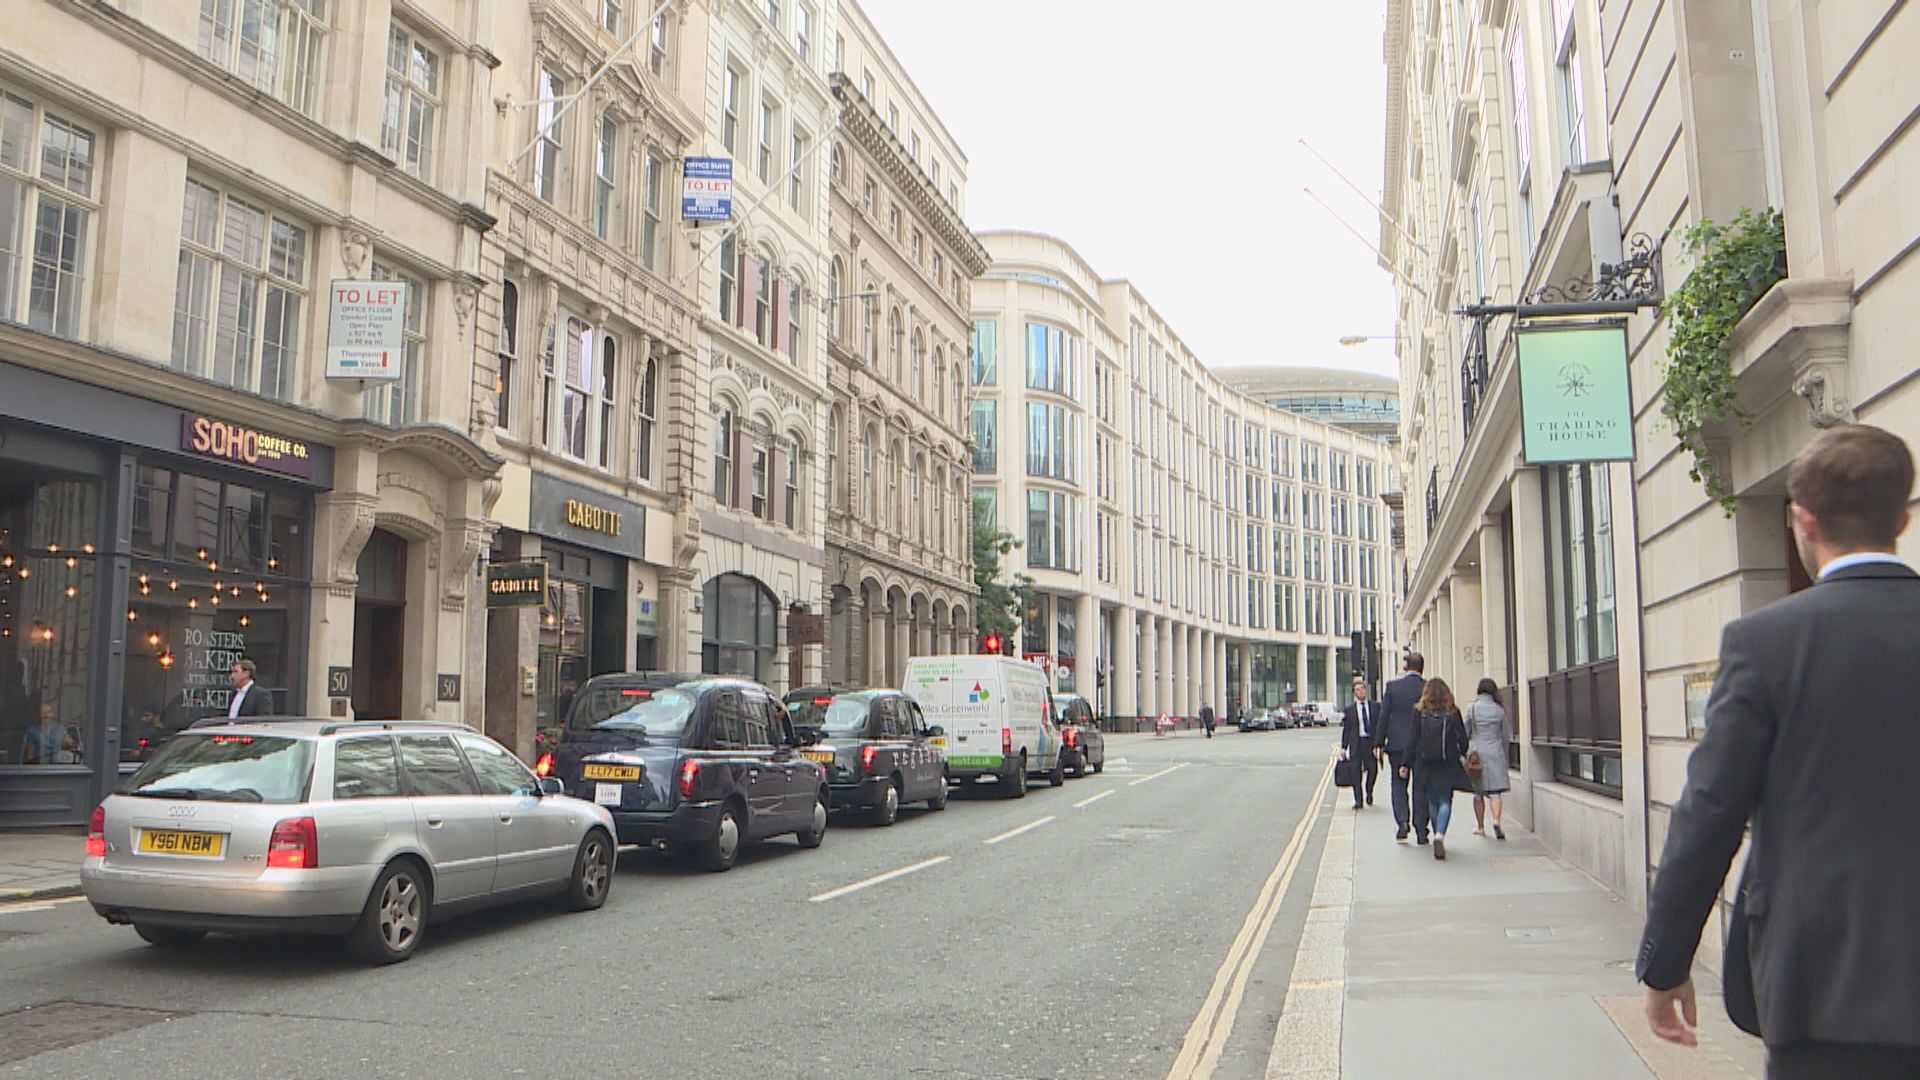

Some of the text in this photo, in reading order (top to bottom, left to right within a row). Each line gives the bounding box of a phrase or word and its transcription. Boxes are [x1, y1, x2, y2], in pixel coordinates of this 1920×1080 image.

[686, 180, 729, 192] TO LET
[336, 289, 400, 305] TO LET
[349, 322, 366, 330] Open
[341, 350, 381, 358] Thompson
[1537, 419, 1616, 431] TRADING
[192, 416, 309, 464] SOHO COFFEE CO.
[1549, 430, 1607, 441] HOUSE
[566, 499, 622, 536] CABOTTE
[491, 577, 540, 593] CABOTTE
[1463, 645, 1484, 664] 85
[331, 671, 348, 692] 50
[442, 679, 456, 698] 50
[941, 703, 990, 713] Greenworld
[614, 766, 634, 778] CWU
[150, 832, 212, 852] Y961 NBM
